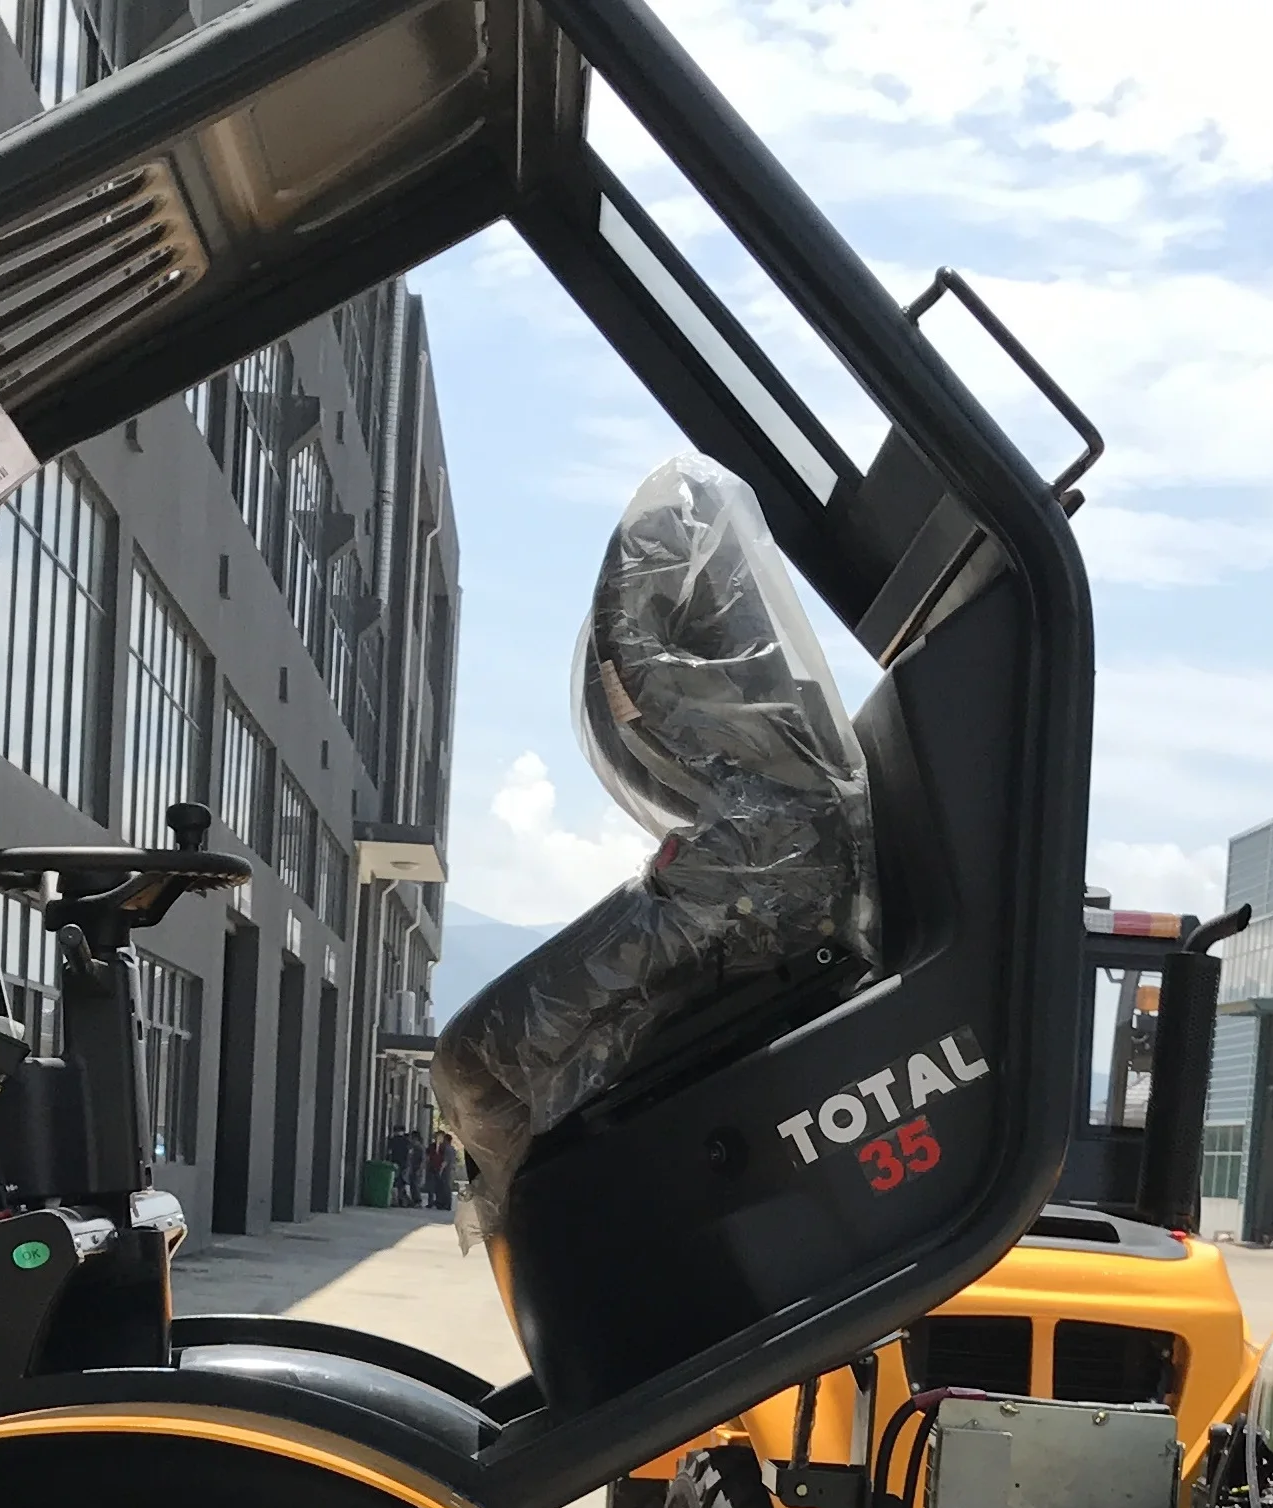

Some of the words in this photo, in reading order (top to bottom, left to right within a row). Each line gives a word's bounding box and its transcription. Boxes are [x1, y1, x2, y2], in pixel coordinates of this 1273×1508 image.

[776, 1035, 990, 1165] TOTAL
[859, 1115, 941, 1191] 35
[21, 1248, 42, 1260] OK
